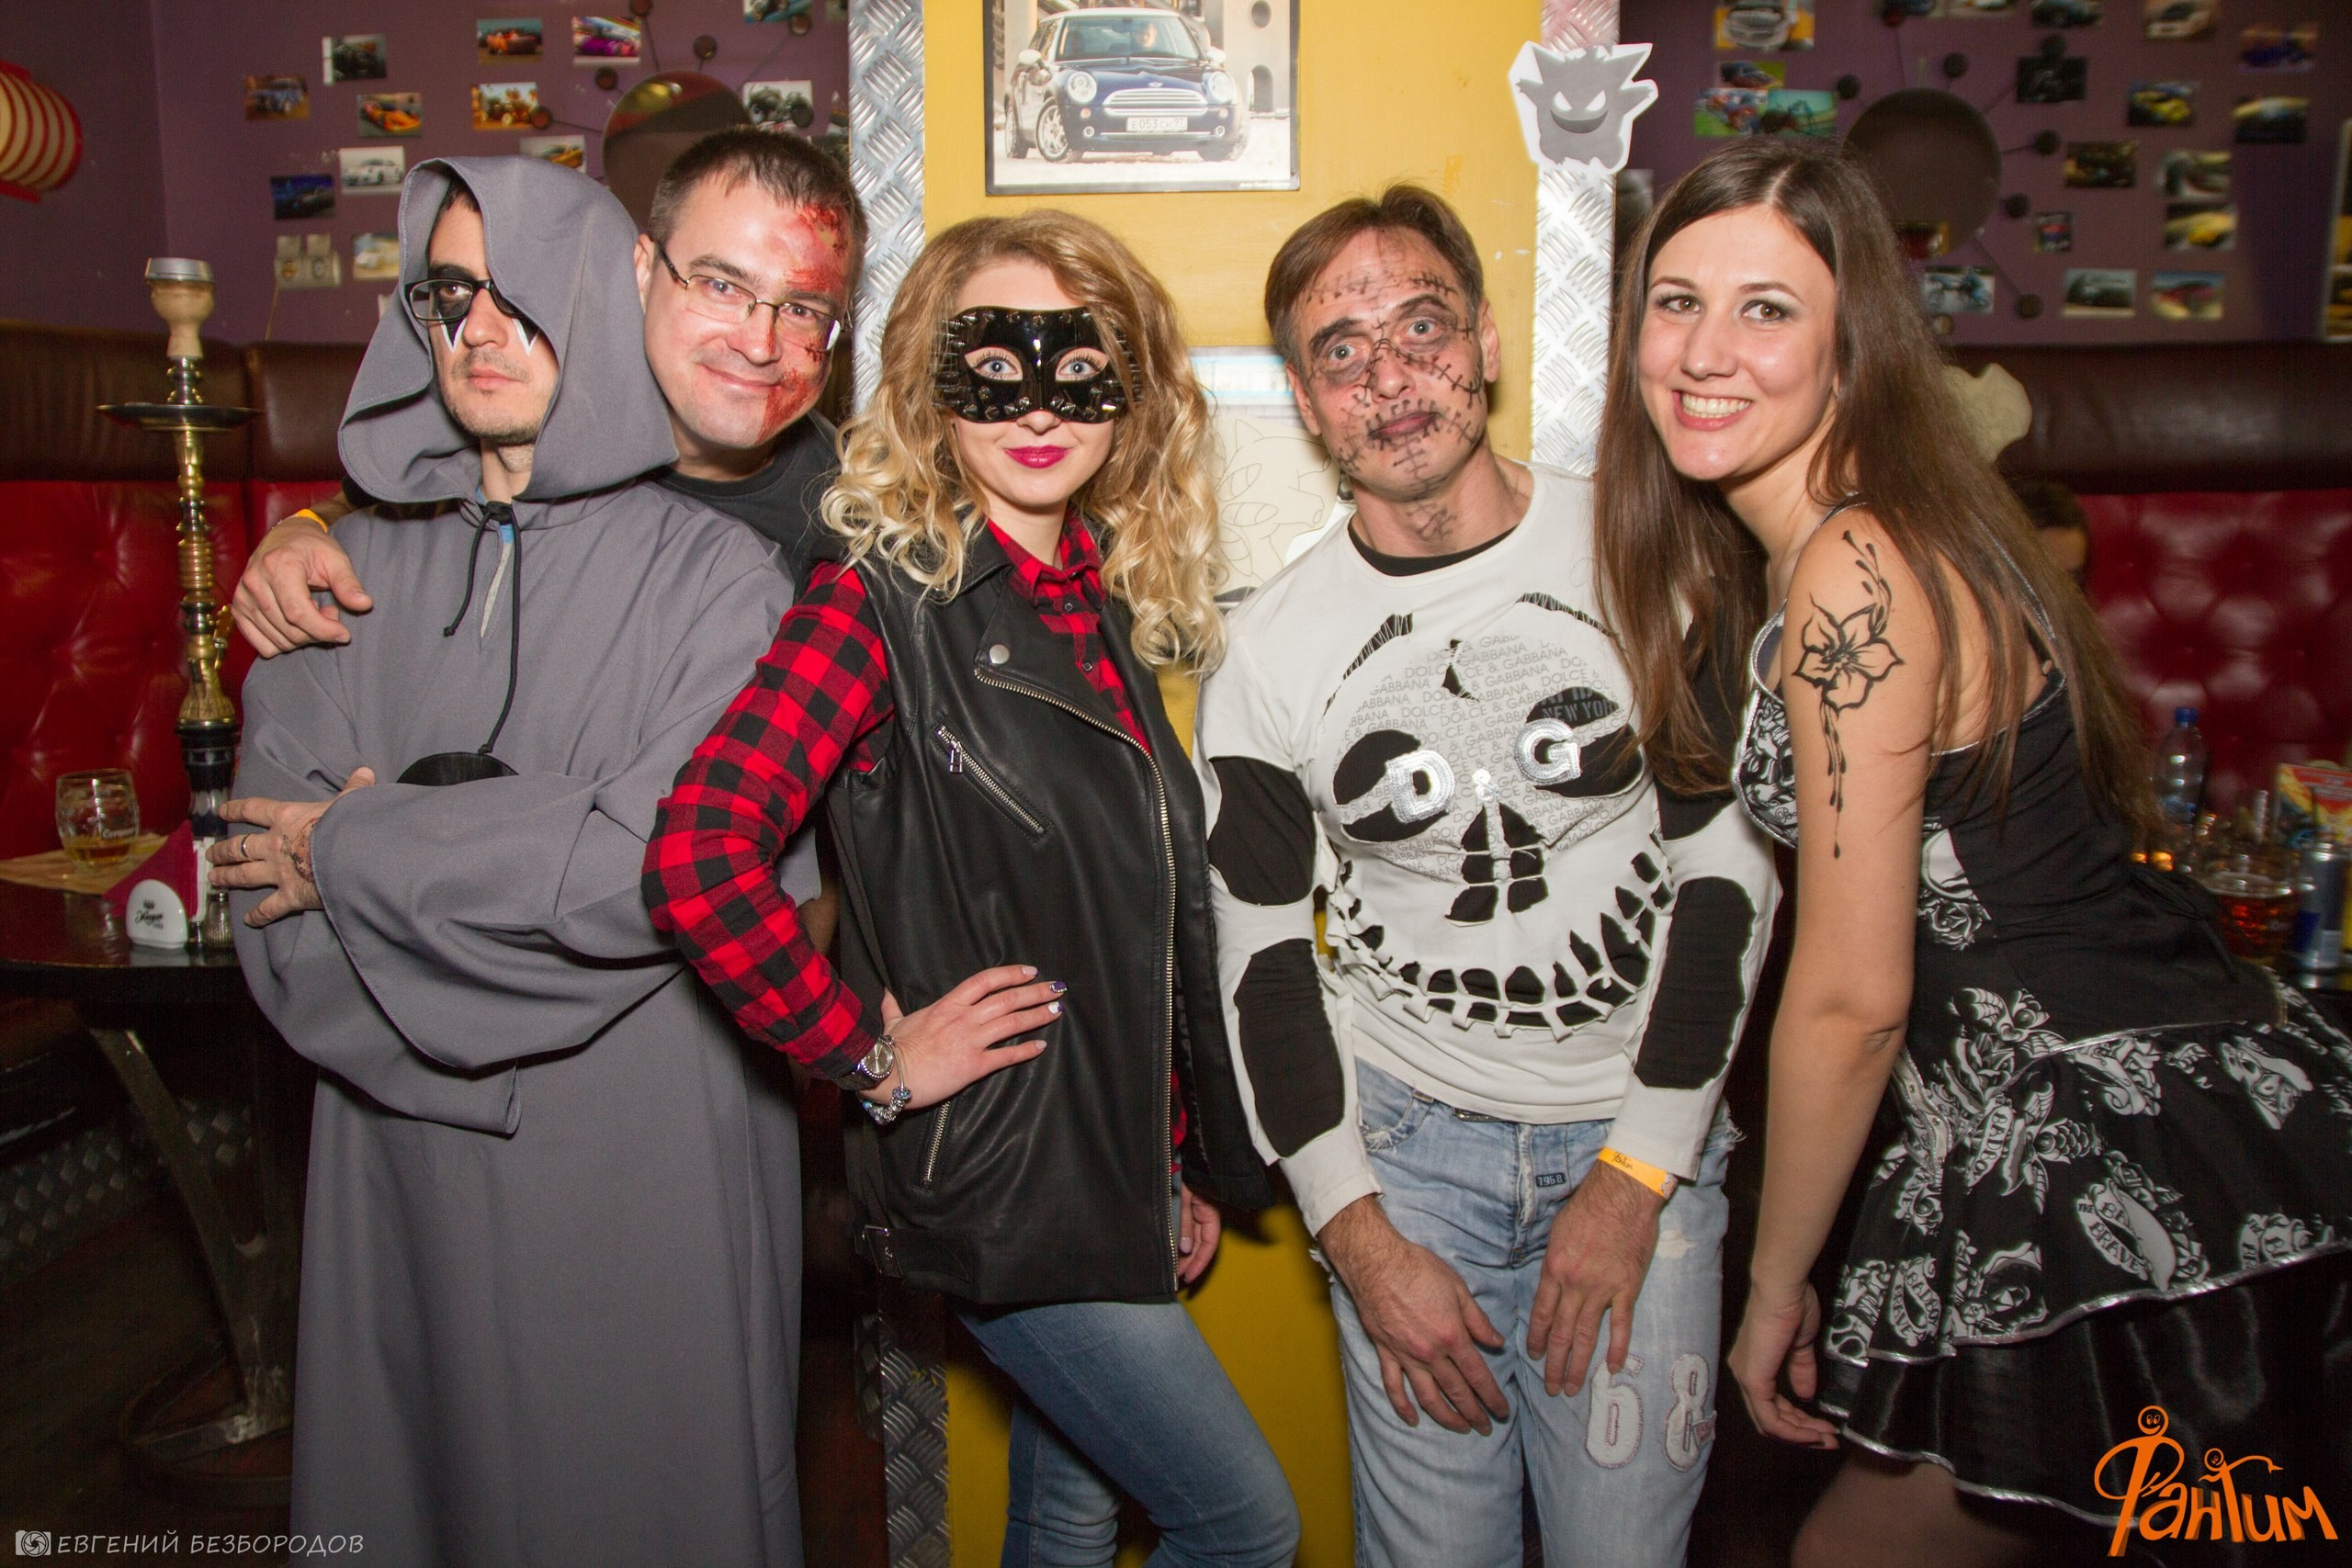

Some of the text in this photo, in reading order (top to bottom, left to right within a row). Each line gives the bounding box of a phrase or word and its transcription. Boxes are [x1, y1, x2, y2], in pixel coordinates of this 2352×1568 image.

[1404, 662, 1449, 679] DOLC
[1503, 647, 1568, 671] GABBANA
[1356, 694, 1410, 713] ABBANA
[1484, 663, 1551, 688] GABBANA
[1401, 703, 1448, 718] DOLCE
[1541, 668, 1588, 688] DOLCE
[1441, 705, 1487, 728] DOLCE
[1385, 750, 1455, 825] D
[1513, 717, 1581, 786] G
[1537, 1174, 1563, 1187] 1968
